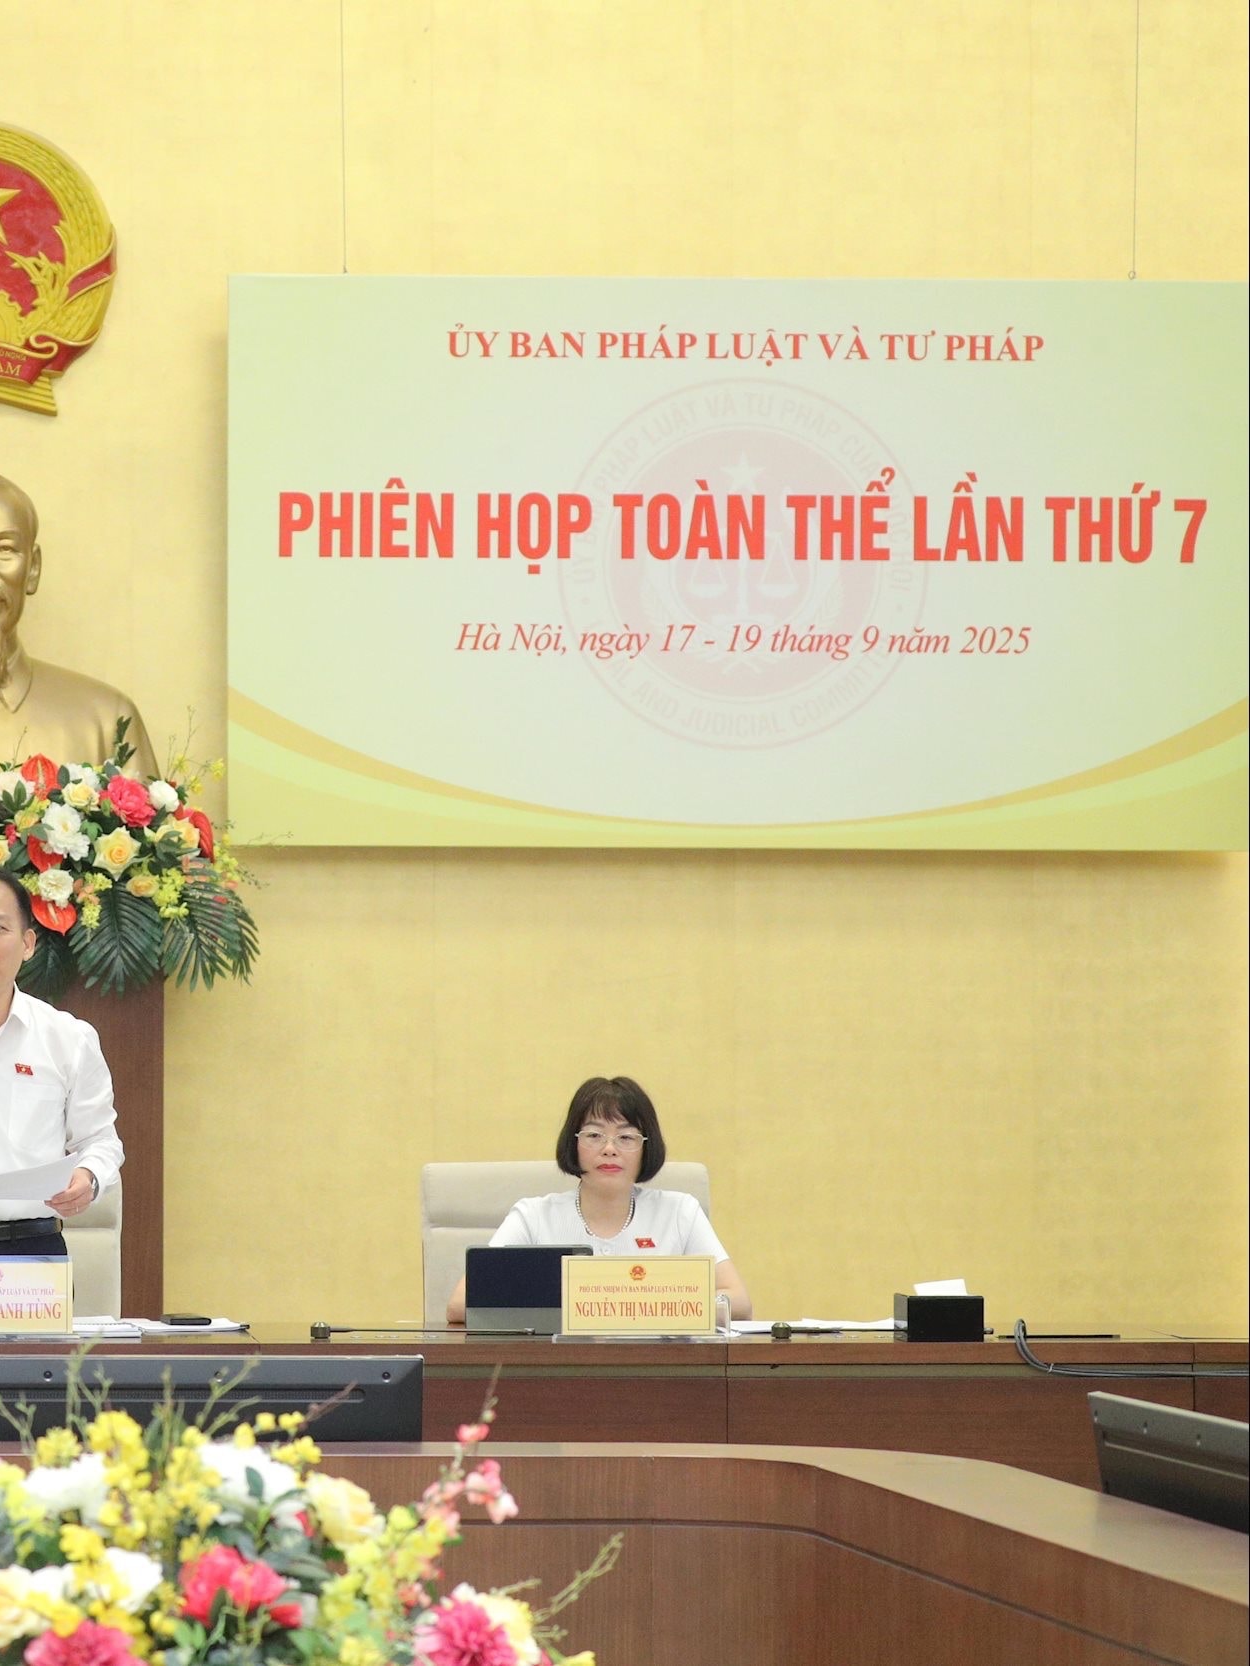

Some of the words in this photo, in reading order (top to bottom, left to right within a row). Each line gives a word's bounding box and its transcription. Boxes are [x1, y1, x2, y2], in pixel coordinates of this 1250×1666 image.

[447, 323, 499, 359] ỦY
[509, 330, 586, 359] BAN
[596, 324, 699, 360] PHÁP
[706, 329, 808, 368] LUẬT
[817, 326, 870, 362] VÀ
[880, 330, 938, 362] TƯ
[945, 327, 1045, 363] PHÁP
[278, 477, 455, 559] PHIÊN
[477, 492, 593, 575] HỌP
[613, 479, 766, 561] TOÀN
[786, 466, 895, 562] THỂ
[913, 471, 1024, 562] LẦN
[1045, 482, 1161, 564] THỨ
[1174, 499, 1208, 564] 7
[455, 623, 502, 651] Hà
[508, 623, 568, 656] Nội,
[579, 624, 652, 659] ngày
[660, 624, 697, 653] 17
[728, 624, 763, 653] 19
[770, 624, 853, 660] tháng
[862, 625, 881, 653] 9
[888, 626, 951, 655] năm
[959, 625, 1033, 655] 2025
[25, 1298, 62, 1320] TÙNG
[575, 1297, 616, 1317] NGUYỄN
[618, 1301, 637, 1321] THỊ
[639, 1301, 658, 1317] MAI
[660, 1299, 703, 1317] PHƯƠNG
